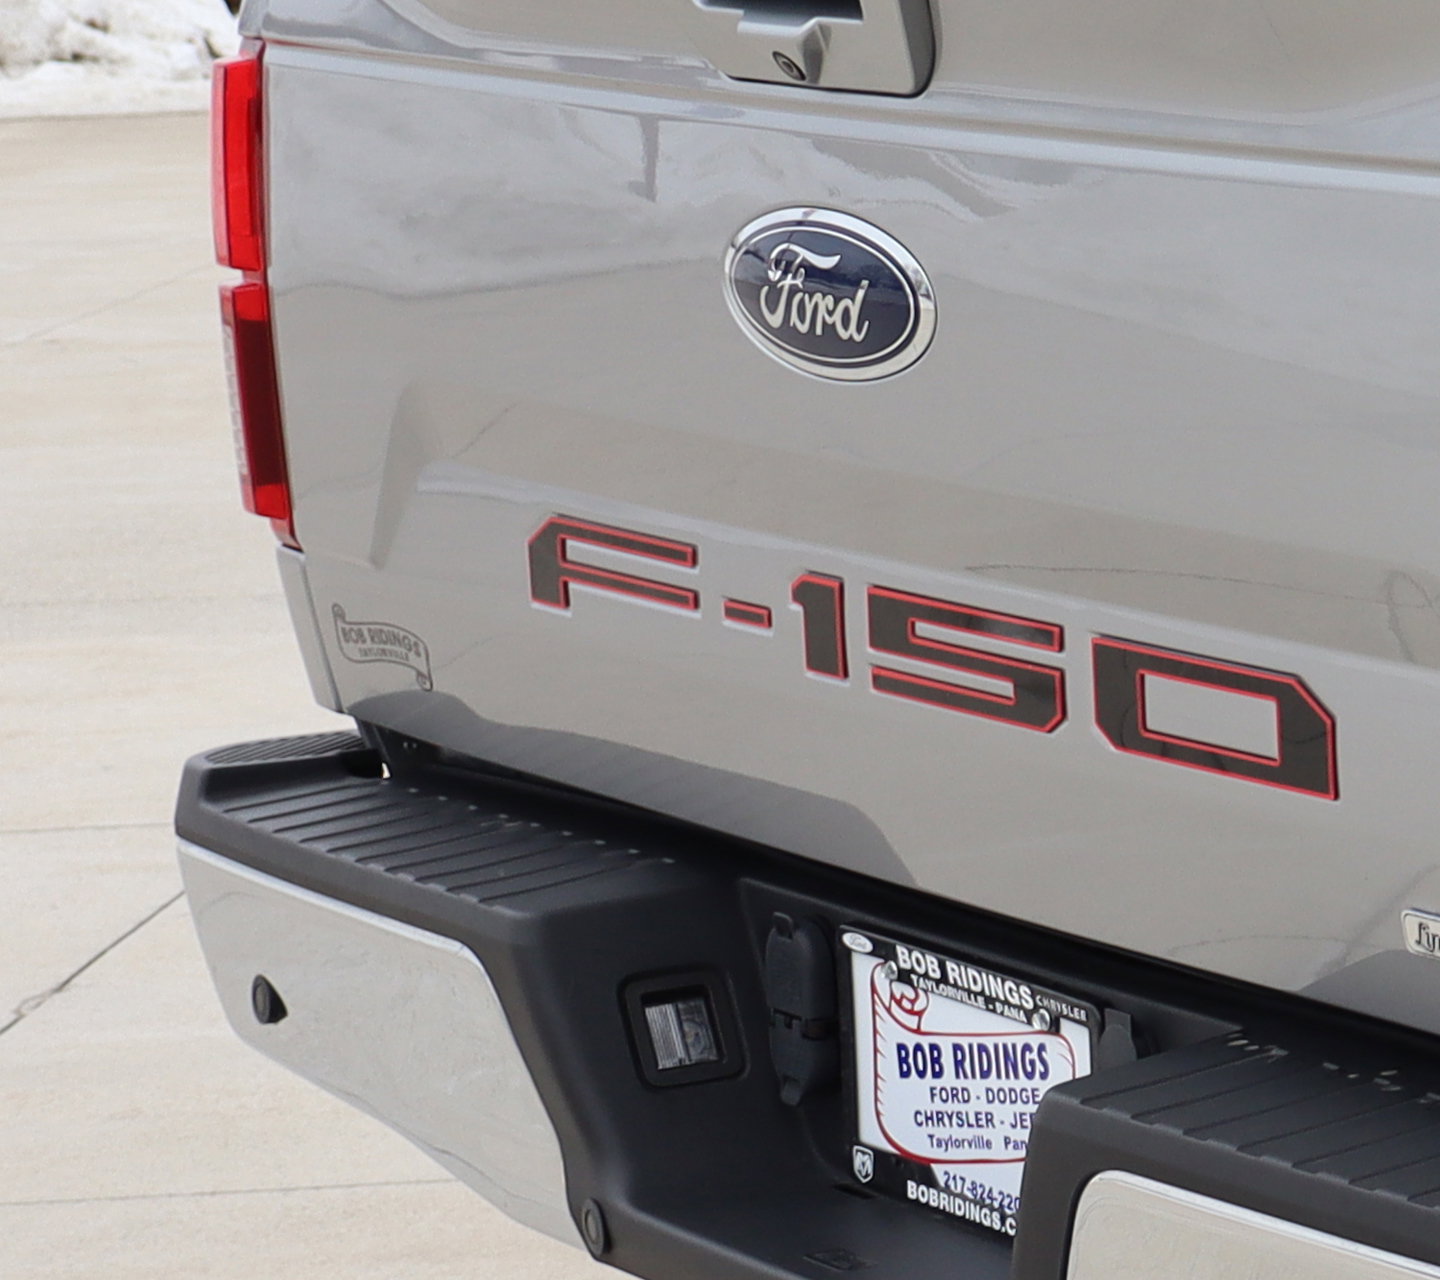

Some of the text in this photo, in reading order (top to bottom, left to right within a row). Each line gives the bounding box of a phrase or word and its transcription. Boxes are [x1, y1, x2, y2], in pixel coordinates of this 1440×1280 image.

[759, 242, 870, 343] Ford
[340, 626, 422, 658] BOB RIDINGS
[526, 511, 1341, 801] F-150
[895, 943, 1035, 1010] BOB RIDINGS
[910, 973, 986, 1010] TAYLORVILLE
[995, 1001, 1028, 1023] PANA
[1035, 994, 1088, 1022] CHRYSLER
[895, 1042, 1050, 1081] BOB RIDINGS
[929, 1086, 971, 1104] FORD
[985, 1086, 1041, 1105] DODGE
[914, 1109, 996, 1129] CHRYSLER
[927, 1133, 993, 1153] Taylorville
[906, 1179, 1018, 1237] BOBRIDINGS.C
